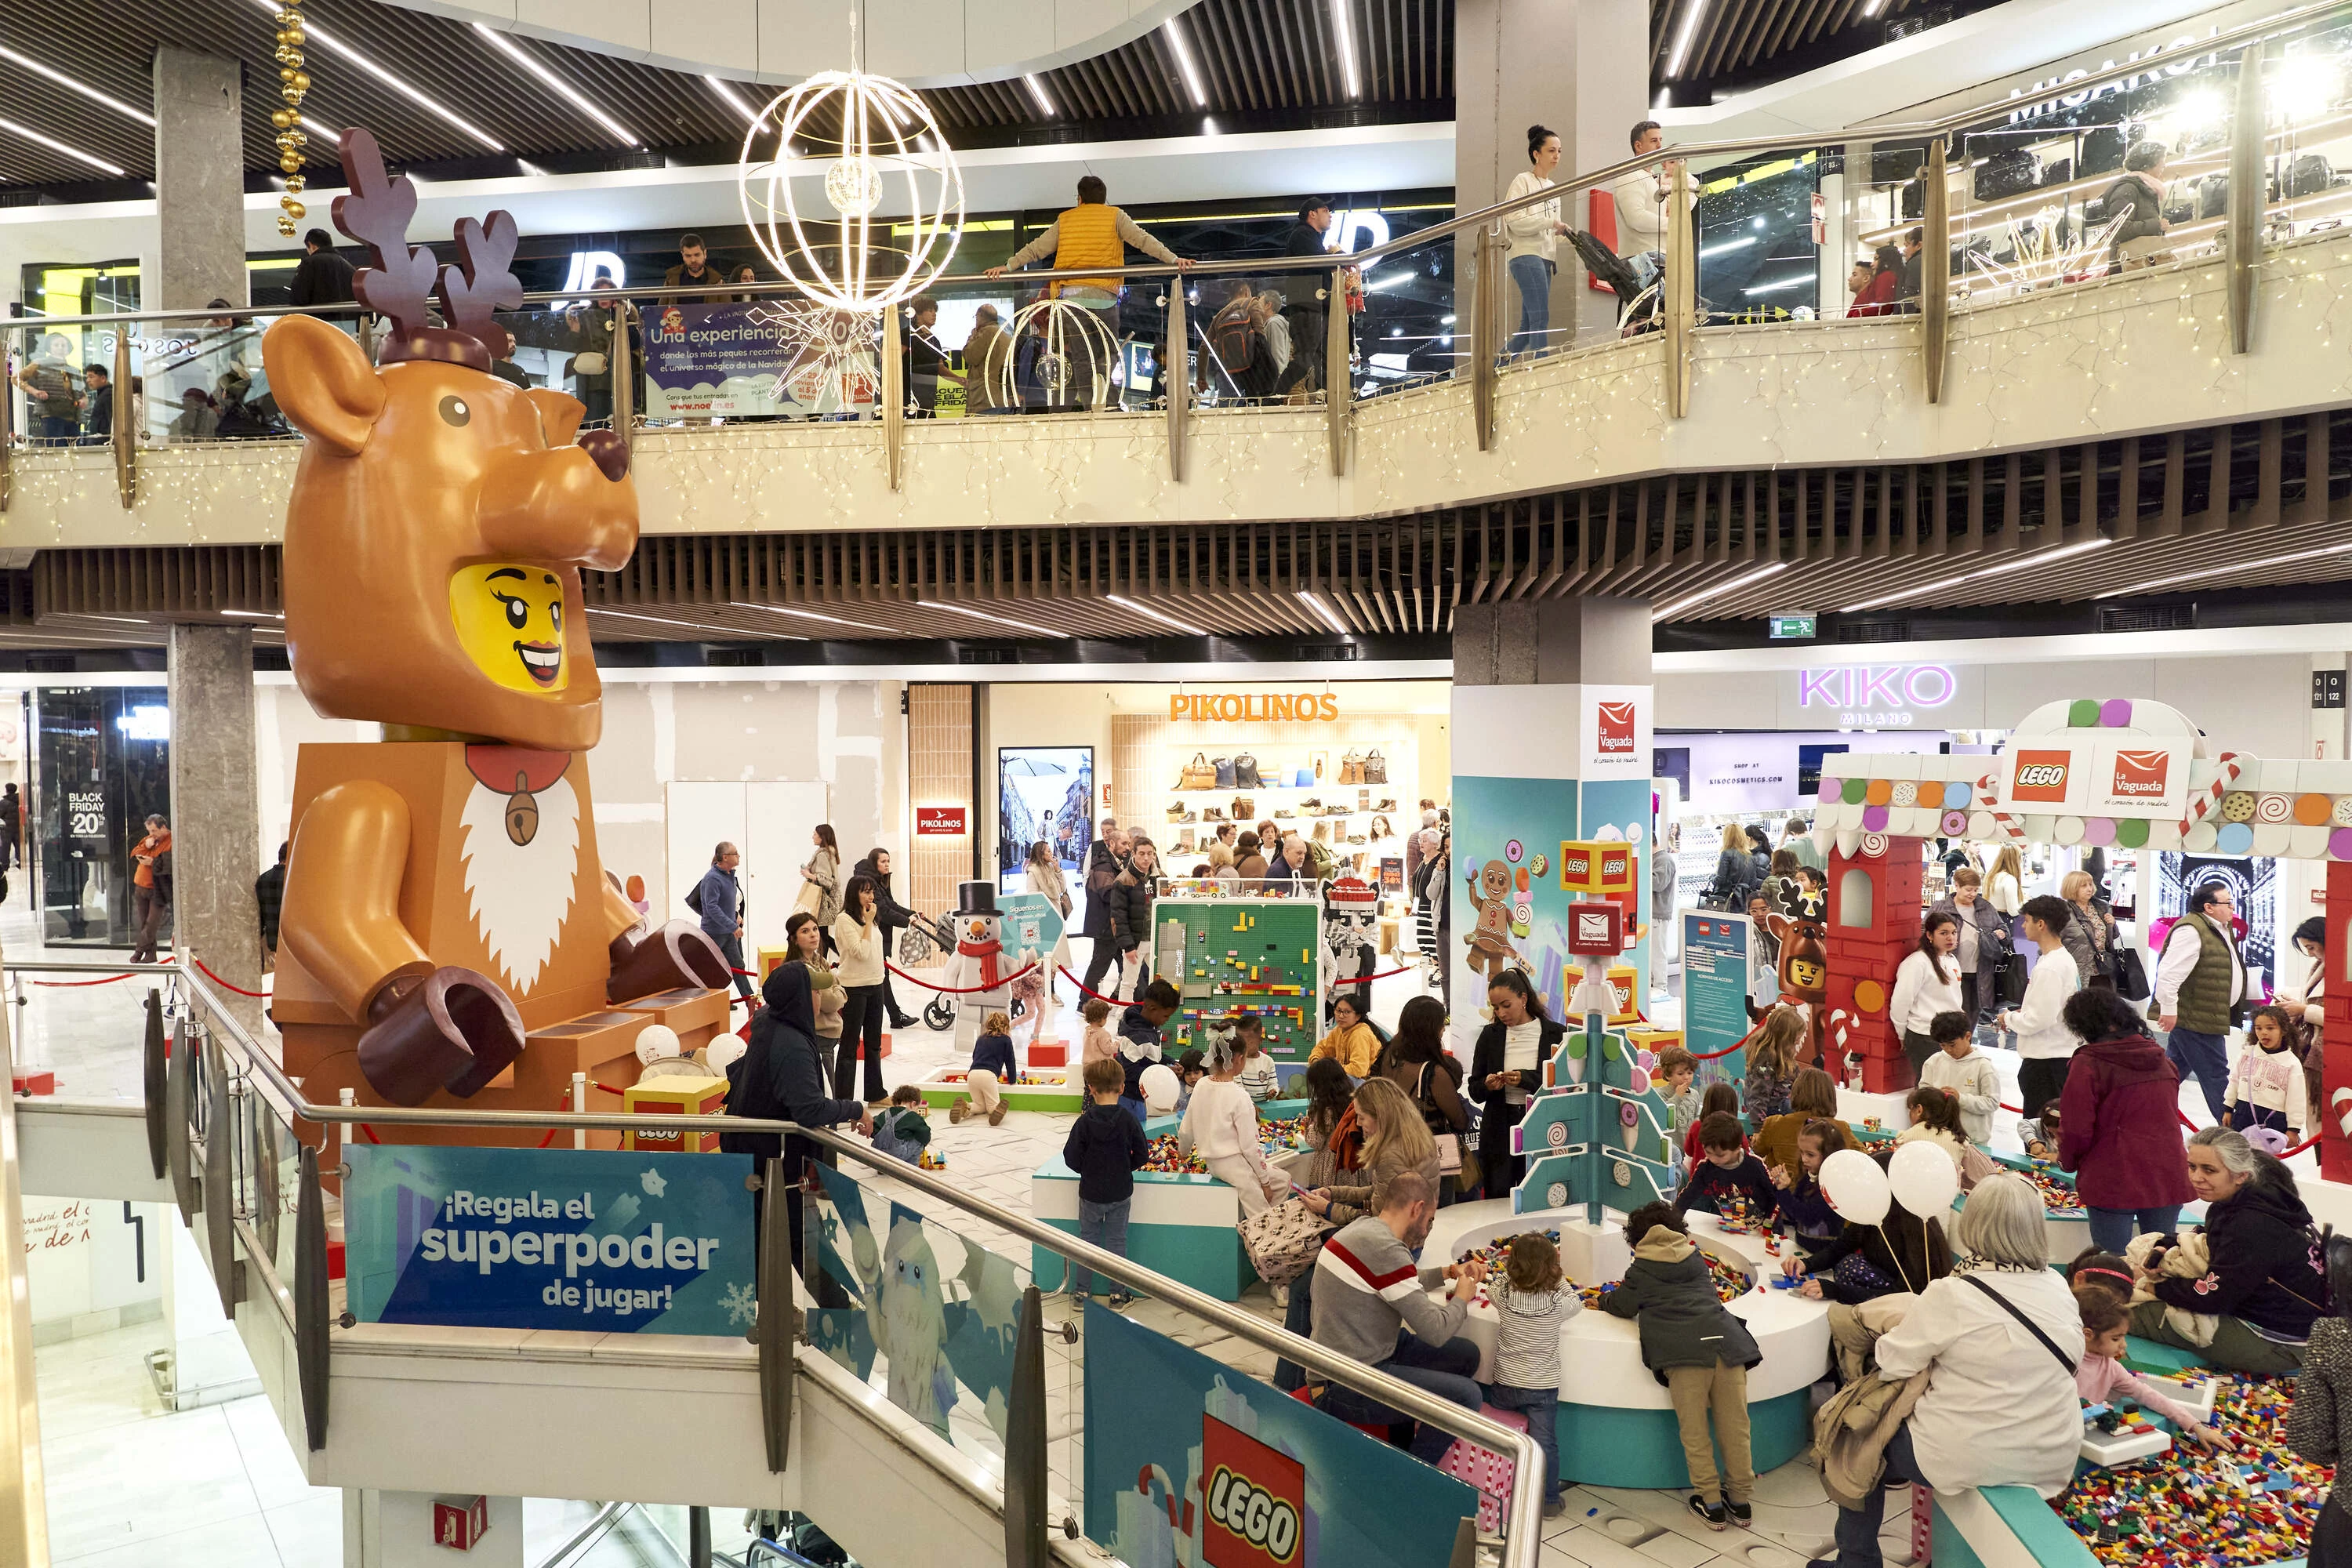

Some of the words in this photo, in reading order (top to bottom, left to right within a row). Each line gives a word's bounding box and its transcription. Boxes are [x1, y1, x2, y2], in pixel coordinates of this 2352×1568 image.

[651, 328, 684, 343] Una
[690, 325, 790, 346] experiencia
[687, 350, 699, 358] los
[700, 349, 717, 358] más
[718, 350, 748, 358] peques
[750, 347, 793, 356] recorrerán
[706, 361, 735, 372] mágico
[758, 360, 792, 368] Navidad
[1800, 666, 1953, 706] KIKO
[1171, 693, 1339, 722] PIKOLINOS
[1841, 714, 1911, 724] MILANO
[1600, 726, 1607, 735] La
[1600, 735, 1633, 750] Vaguada
[2018, 766, 2065, 786] LEGO
[2117, 781, 2163, 793] Vaguada
[68, 793, 103, 802] BLACK
[69, 803, 105, 811] FRIDAY
[920, 819, 961, 828] PIKOLINOS
[1567, 859, 1588, 873] LEGO
[1603, 860, 1625, 875] LEGO
[1581, 931, 1607, 939] Vaguada
[63, 1200, 80, 1219] el
[445, 1190, 559, 1224] ¡Regala
[565, 1192, 595, 1220] el
[45, 1229, 74, 1248] de
[420, 1222, 720, 1278] superpoder
[543, 1279, 580, 1307] de
[583, 1279, 673, 1316] jugar!
[1210, 1468, 1297, 1559] LEGO
